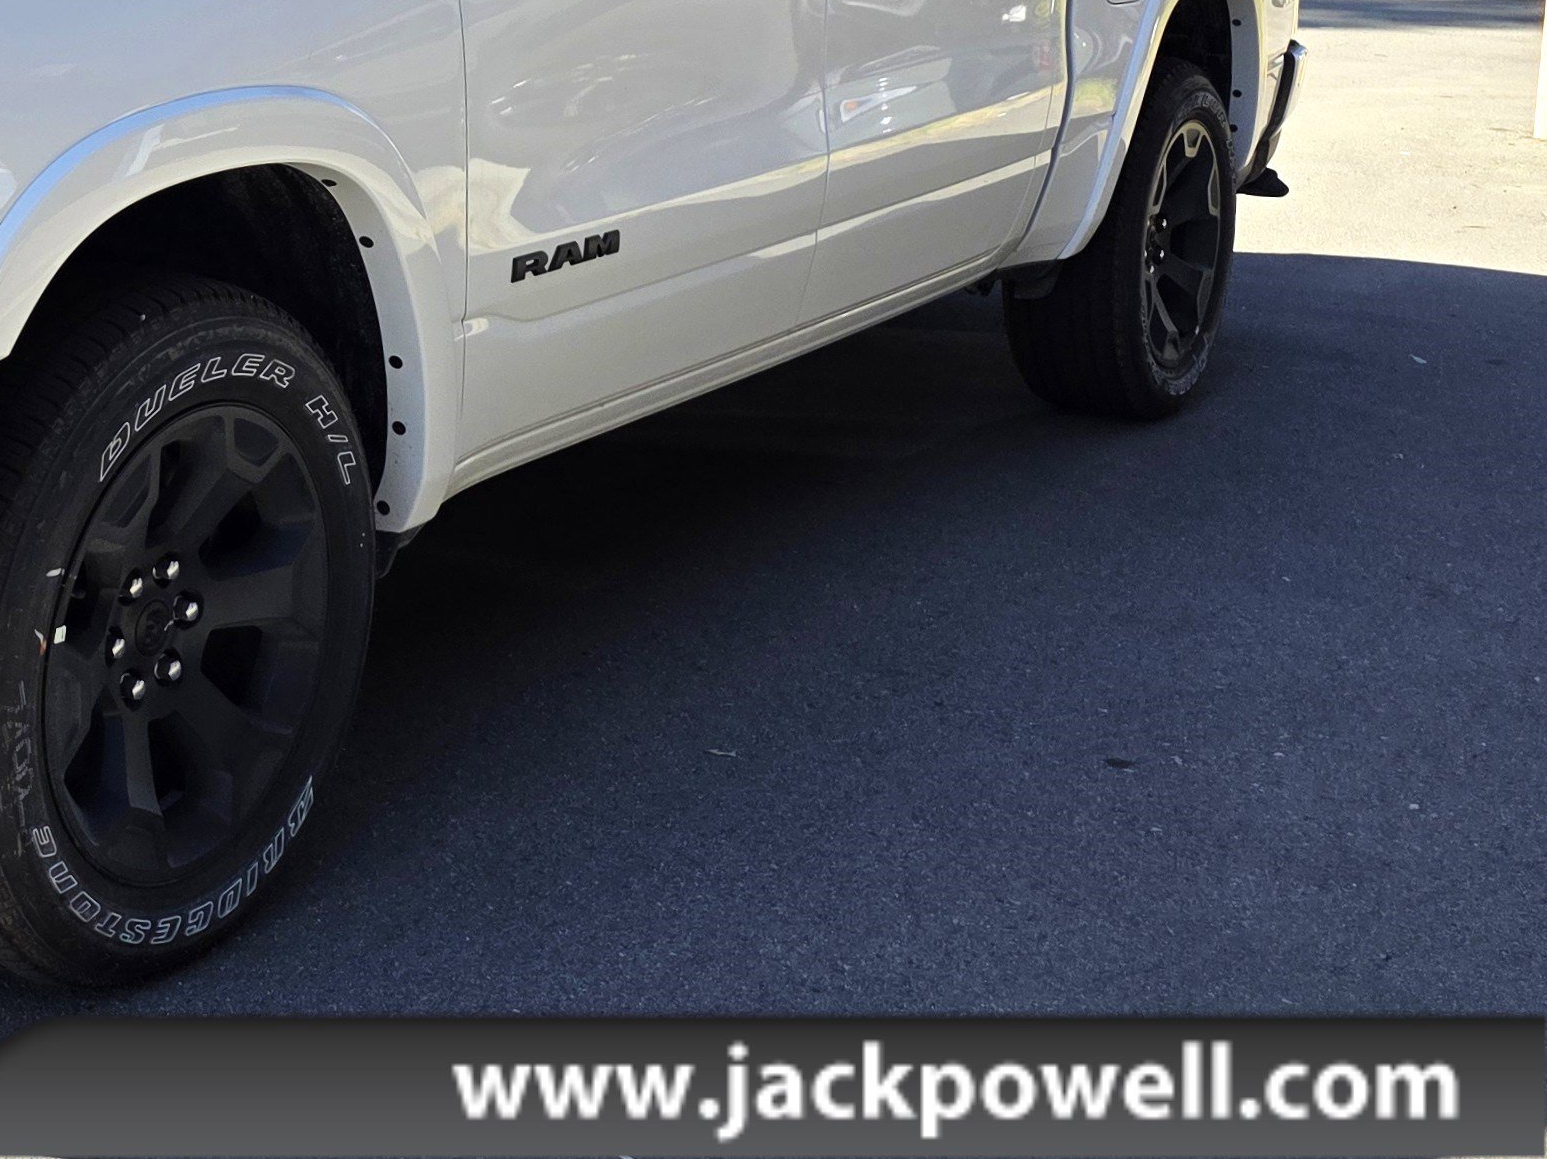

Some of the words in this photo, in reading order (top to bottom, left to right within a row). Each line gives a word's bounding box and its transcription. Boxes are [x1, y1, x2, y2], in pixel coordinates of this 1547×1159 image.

[511, 229, 621, 283] RAM
[99, 353, 296, 482] DUELER
[32, 775, 314, 945] BRIDGESTONE
